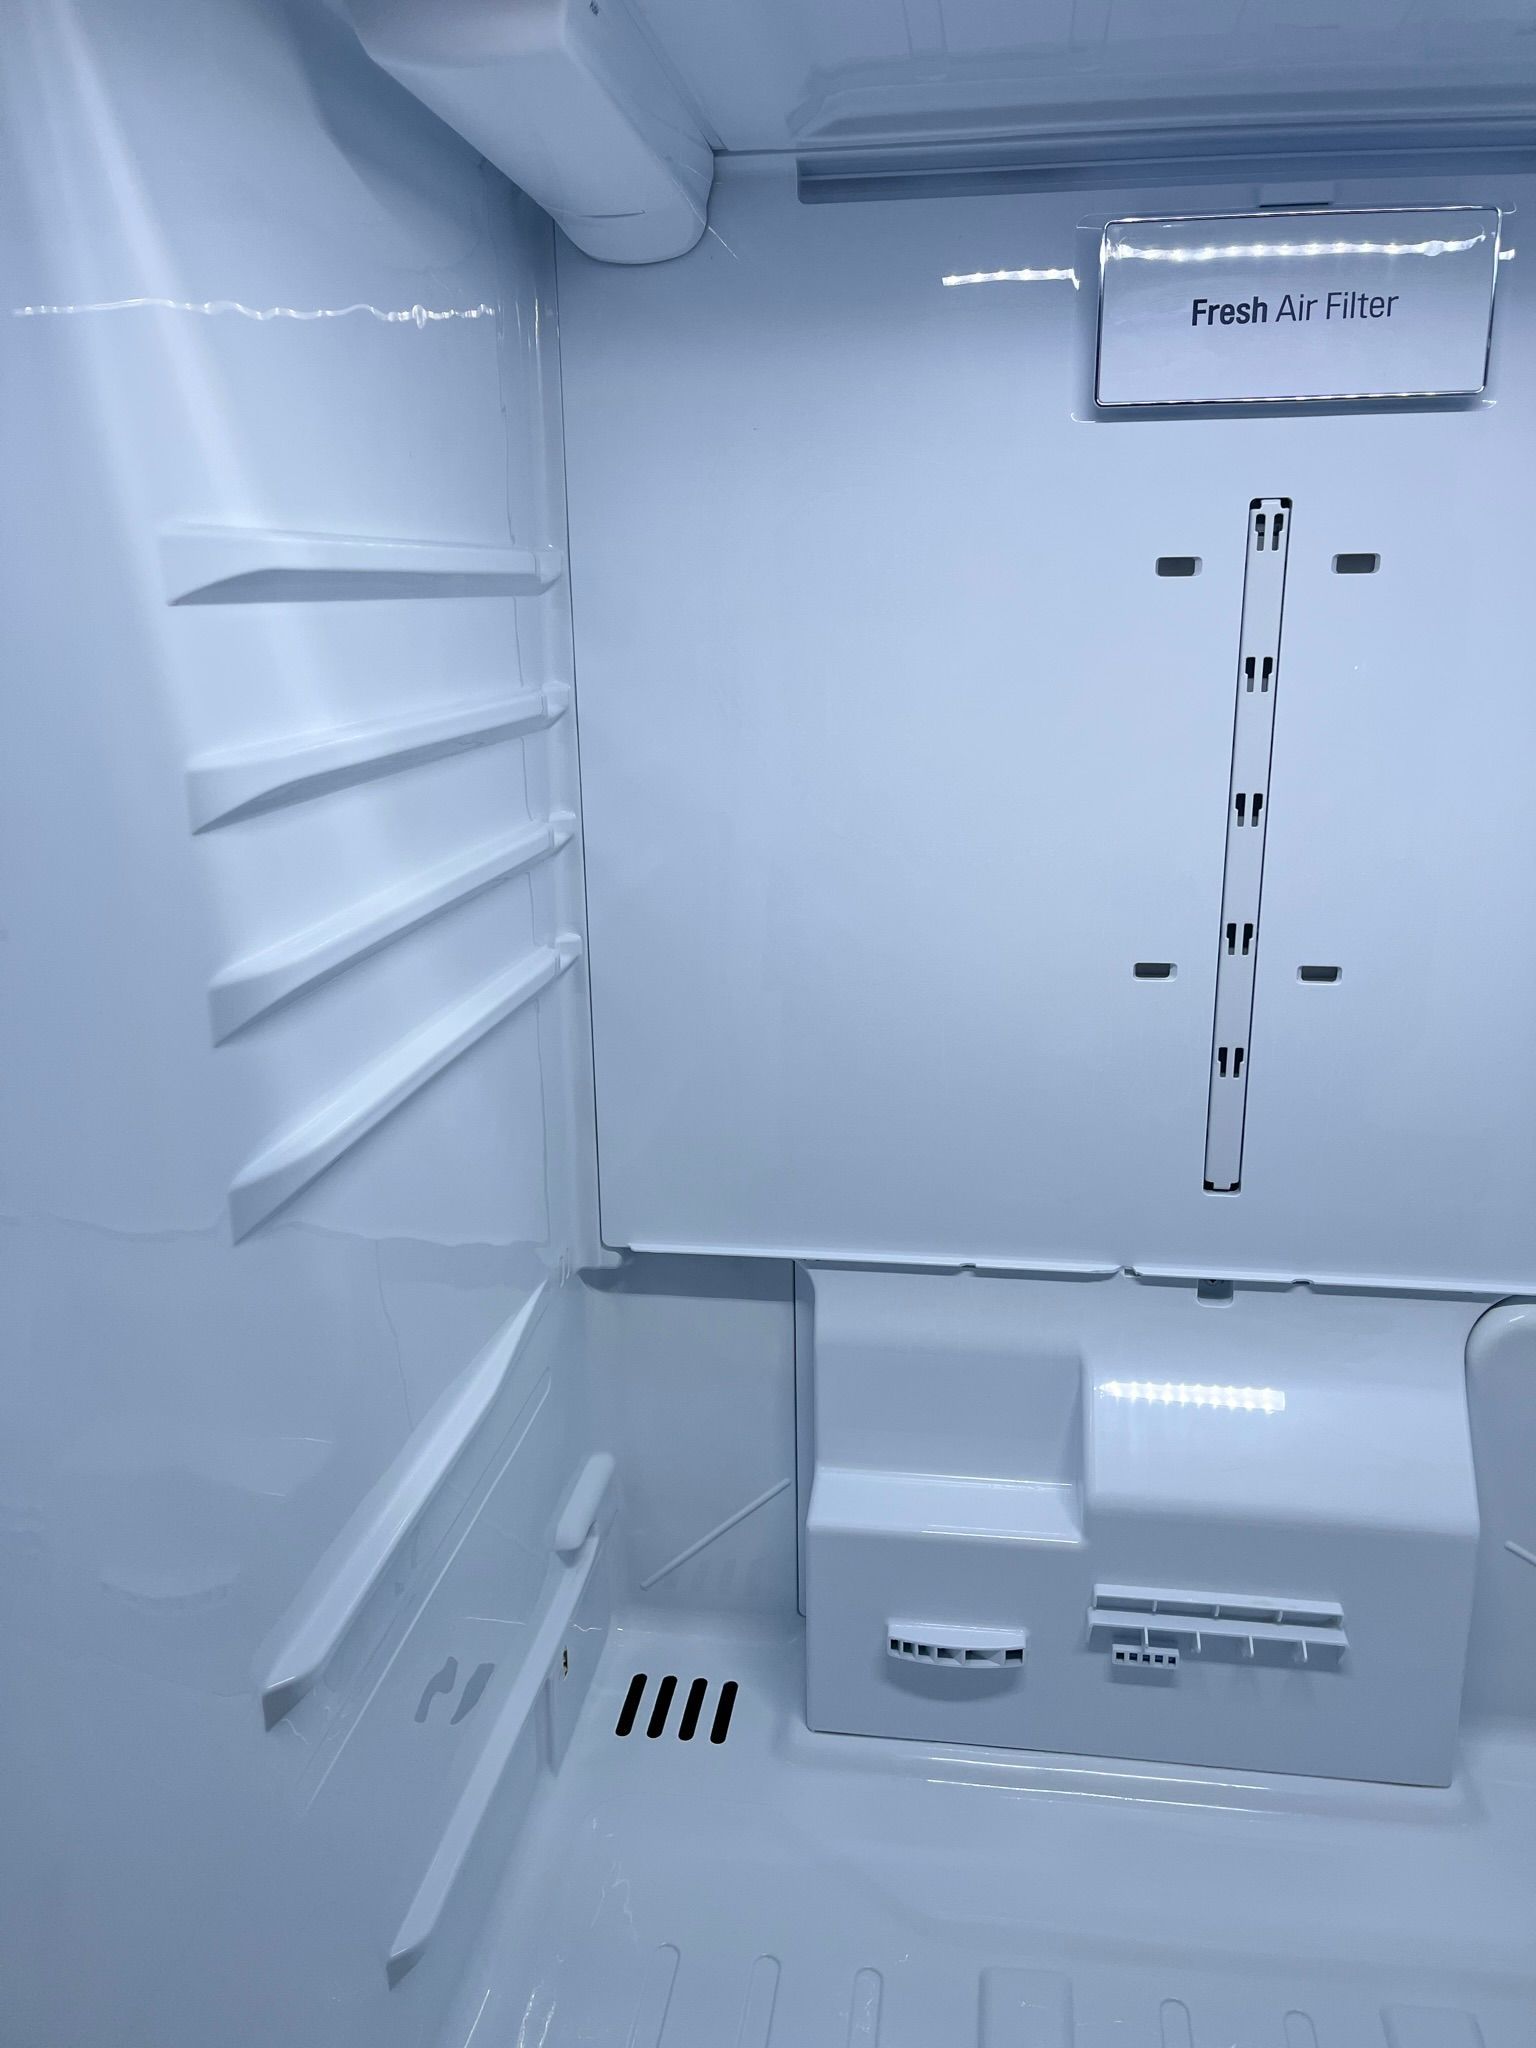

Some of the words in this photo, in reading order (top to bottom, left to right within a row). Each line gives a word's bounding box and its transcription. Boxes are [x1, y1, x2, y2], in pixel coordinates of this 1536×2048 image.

[1192, 296, 1267, 326] Fresh
[1275, 294, 1318, 322] Air
[1326, 291, 1399, 320] Filter
